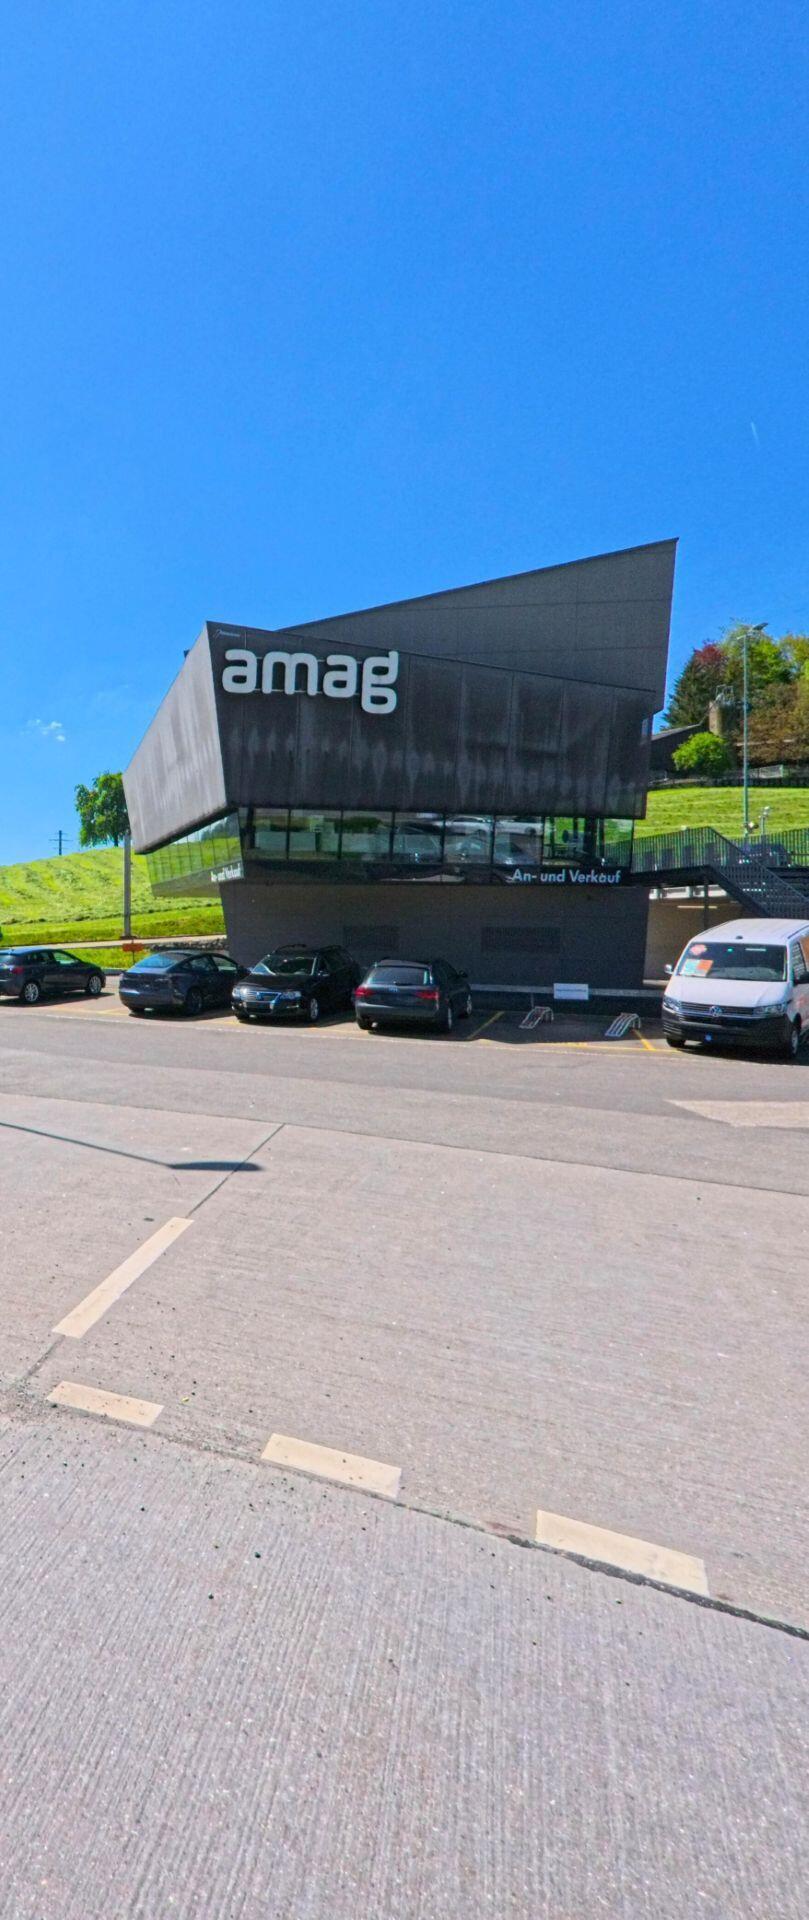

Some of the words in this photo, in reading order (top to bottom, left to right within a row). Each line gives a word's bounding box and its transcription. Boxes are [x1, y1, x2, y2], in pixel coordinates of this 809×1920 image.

[222, 649, 399, 714] amag
[512, 868, 537, 882] An-
[541, 869, 565, 882] und
[569, 869, 621, 884] Verkauf
